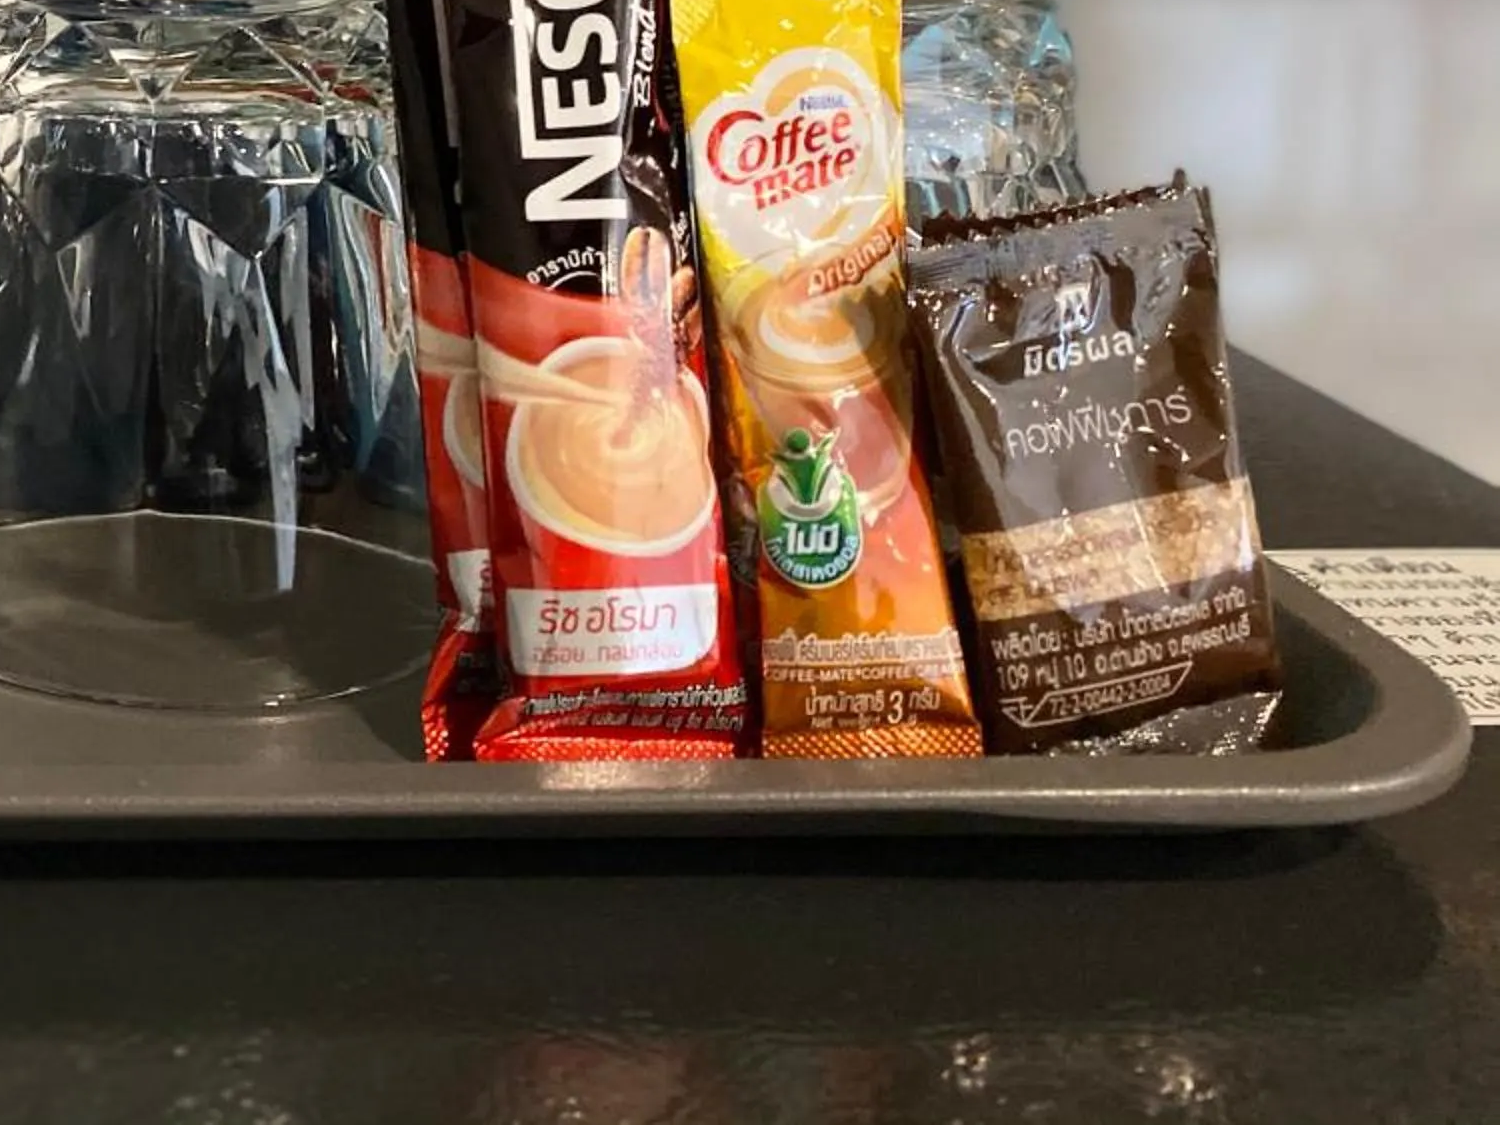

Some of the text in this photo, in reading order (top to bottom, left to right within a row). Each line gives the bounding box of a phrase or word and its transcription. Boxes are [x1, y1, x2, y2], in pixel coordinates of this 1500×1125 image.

[631, 6, 658, 108] Blend
[705, 106, 853, 186] Coffee
[753, 145, 858, 212] mate
[807, 225, 896, 297] Original
[1063, 652, 1086, 682] 10
[886, 689, 904, 724] 3
